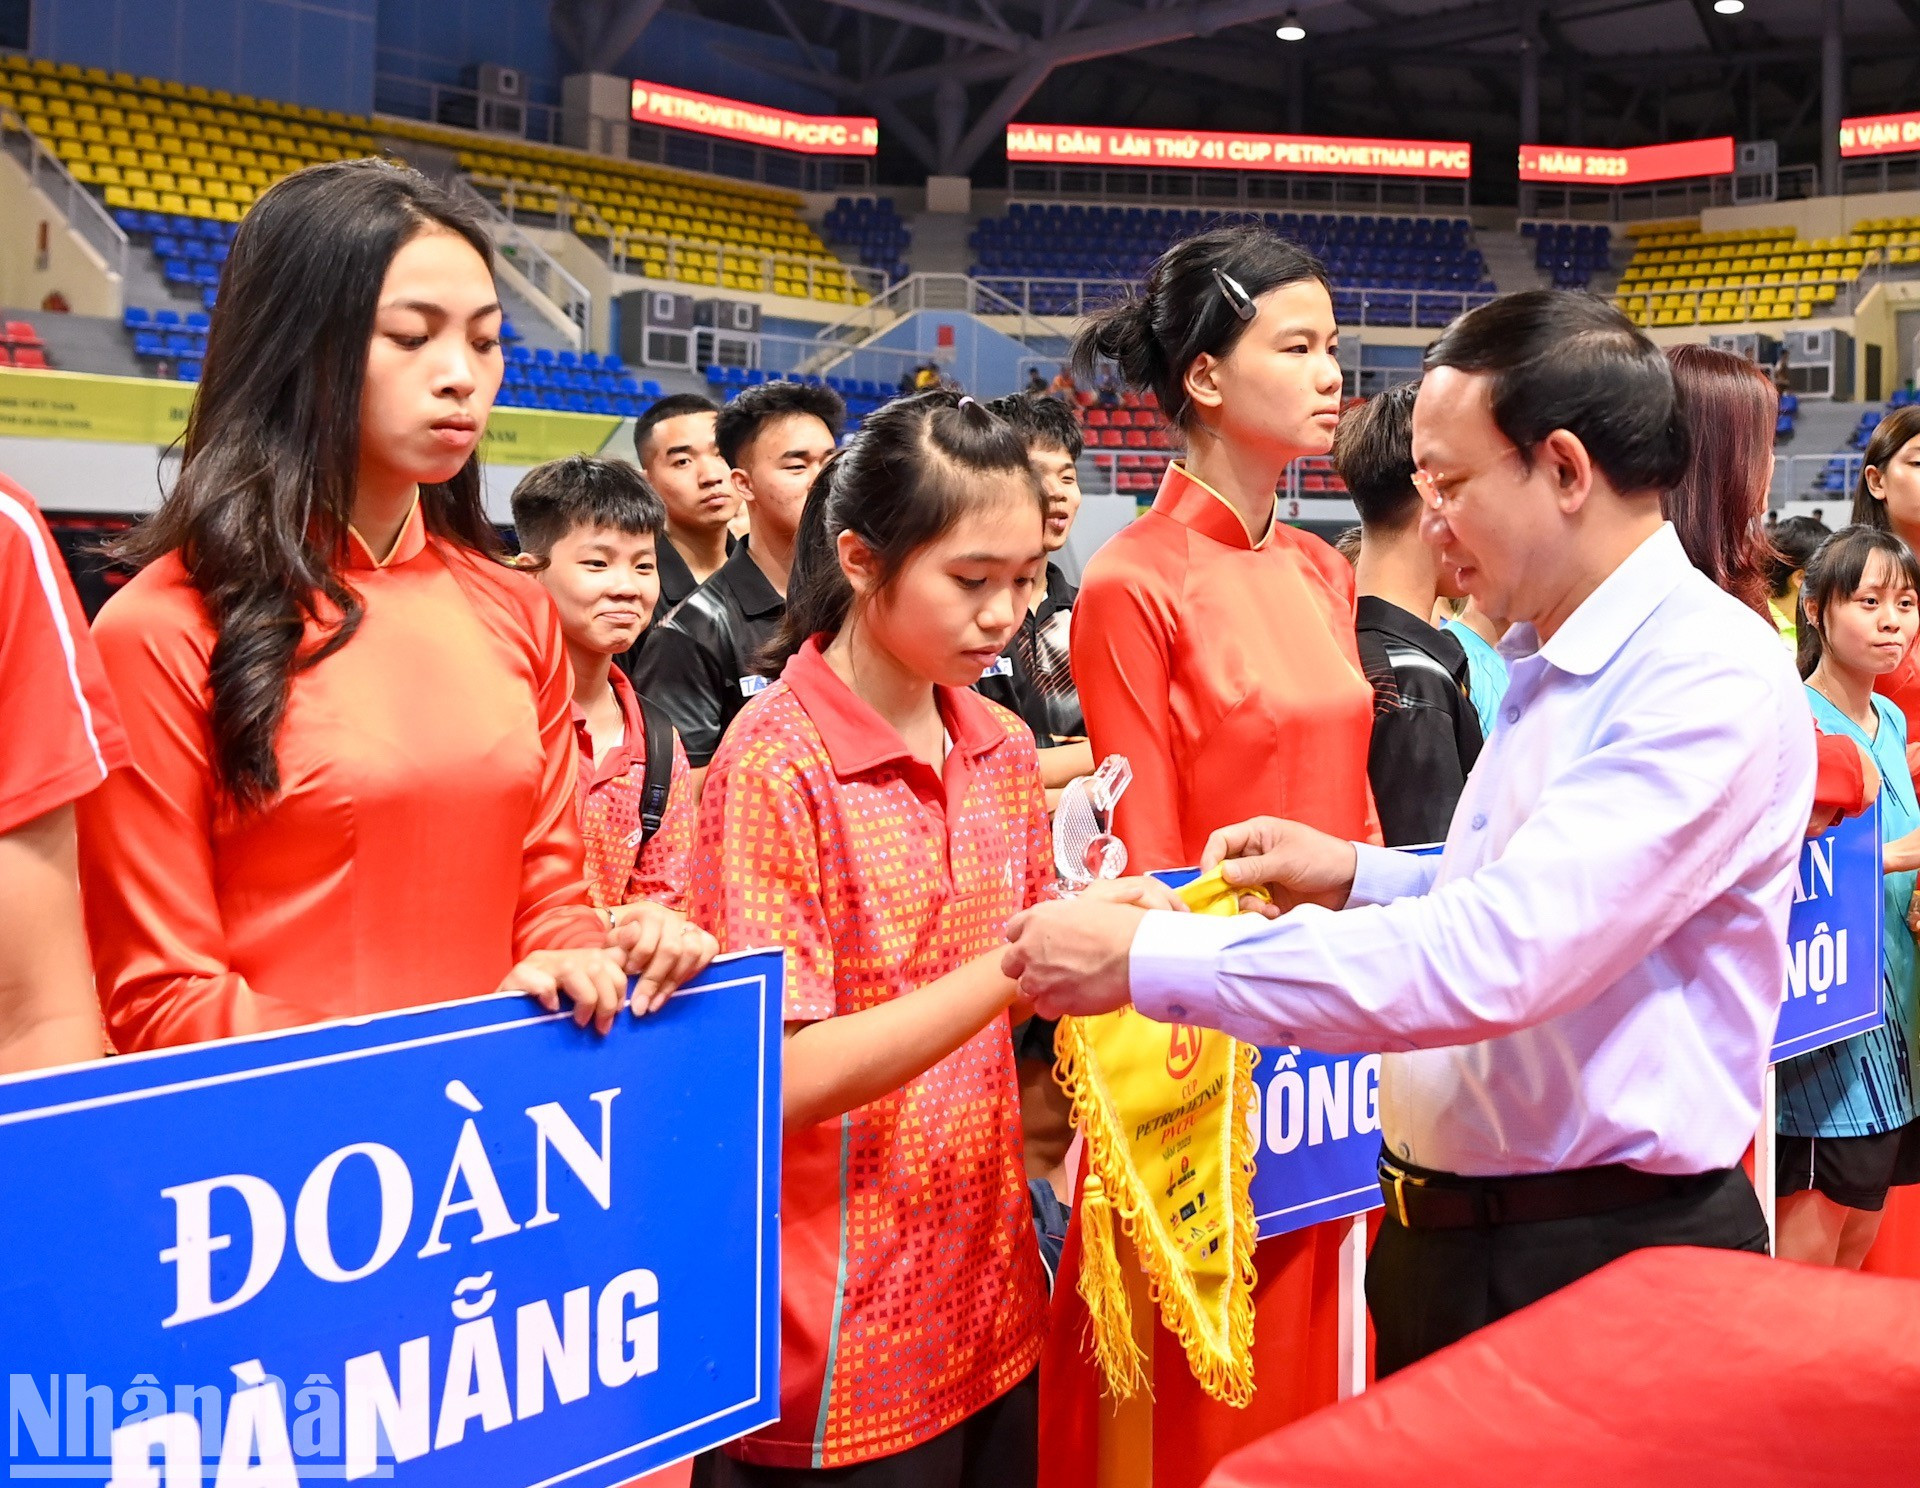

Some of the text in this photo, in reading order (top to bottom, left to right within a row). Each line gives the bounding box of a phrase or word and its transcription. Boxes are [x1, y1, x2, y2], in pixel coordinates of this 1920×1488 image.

[1201, 141, 1224, 160] 41
[1228, 141, 1272, 161] CUP
[1274, 143, 1426, 168] PETROVIETNAM
[1584, 156, 1628, 176] 2023
[1288, 502, 1300, 517] 3
[1781, 921, 1848, 1005] NỘI
[160, 1079, 622, 1328] ĐOÀN
[345, 1268, 660, 1481] NẴNG
